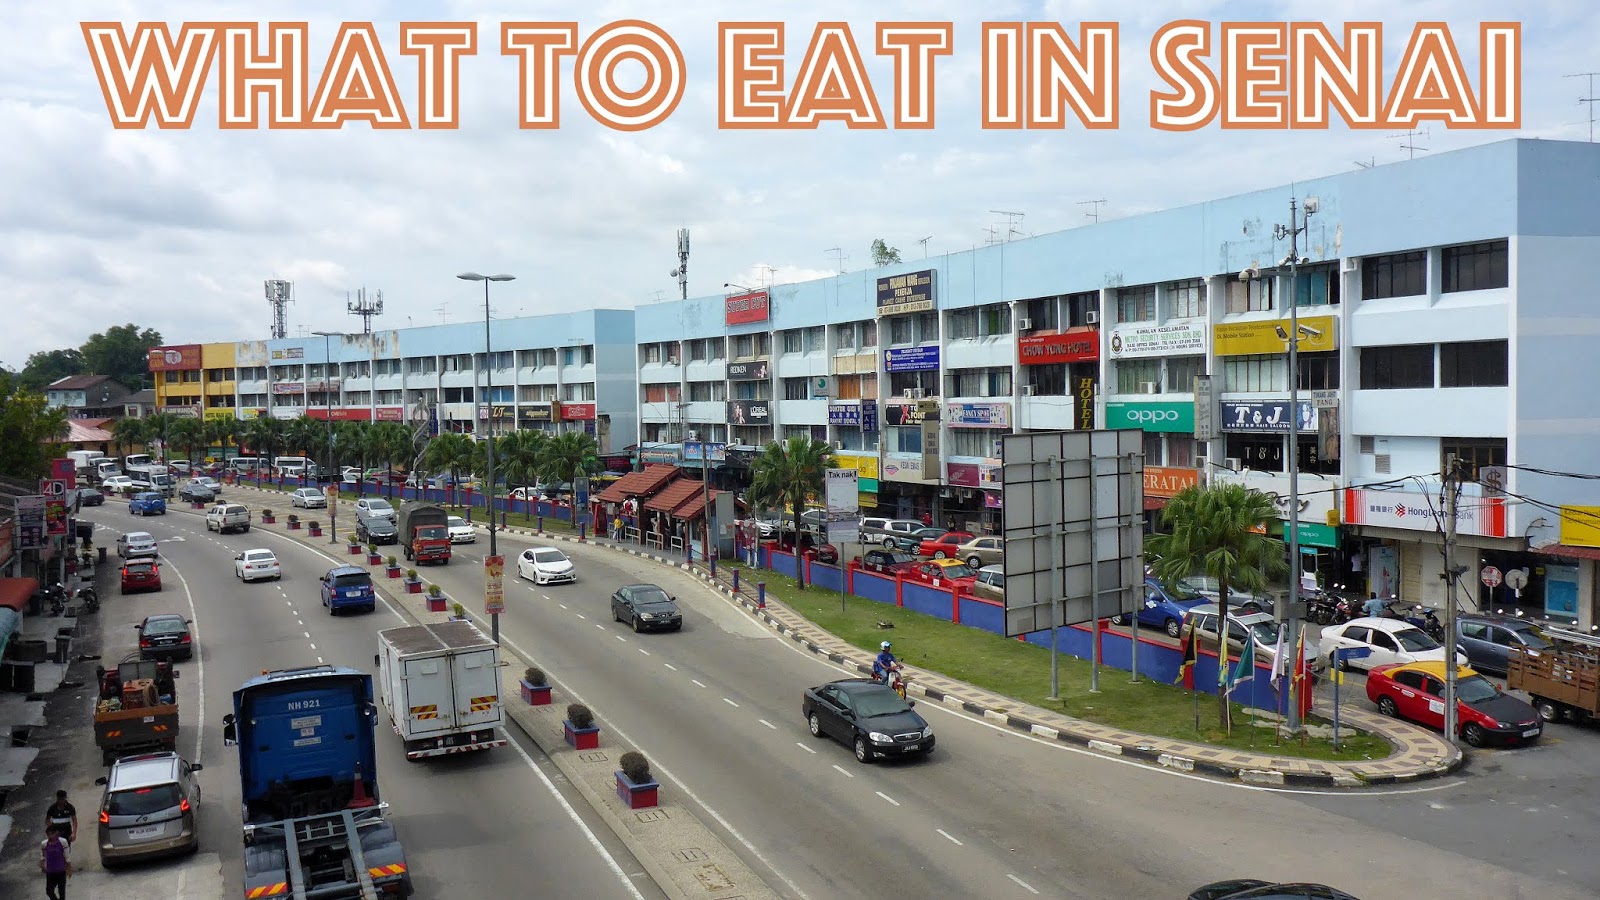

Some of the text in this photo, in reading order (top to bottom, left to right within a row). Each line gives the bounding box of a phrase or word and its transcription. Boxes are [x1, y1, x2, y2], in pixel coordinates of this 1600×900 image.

[1068, 341, 1092, 354] HOTEL
[1079, 378, 1094, 429] HOTEL
[1127, 410, 1179, 424] oppo
[1234, 407, 1283, 424] T & J
[1245, 446, 1251, 460] T
[1259, 447, 1267, 460] &
[828, 471, 840, 479] Tak
[1408, 506, 1428, 519] Hong
[288, 699, 321, 711] NH 921
